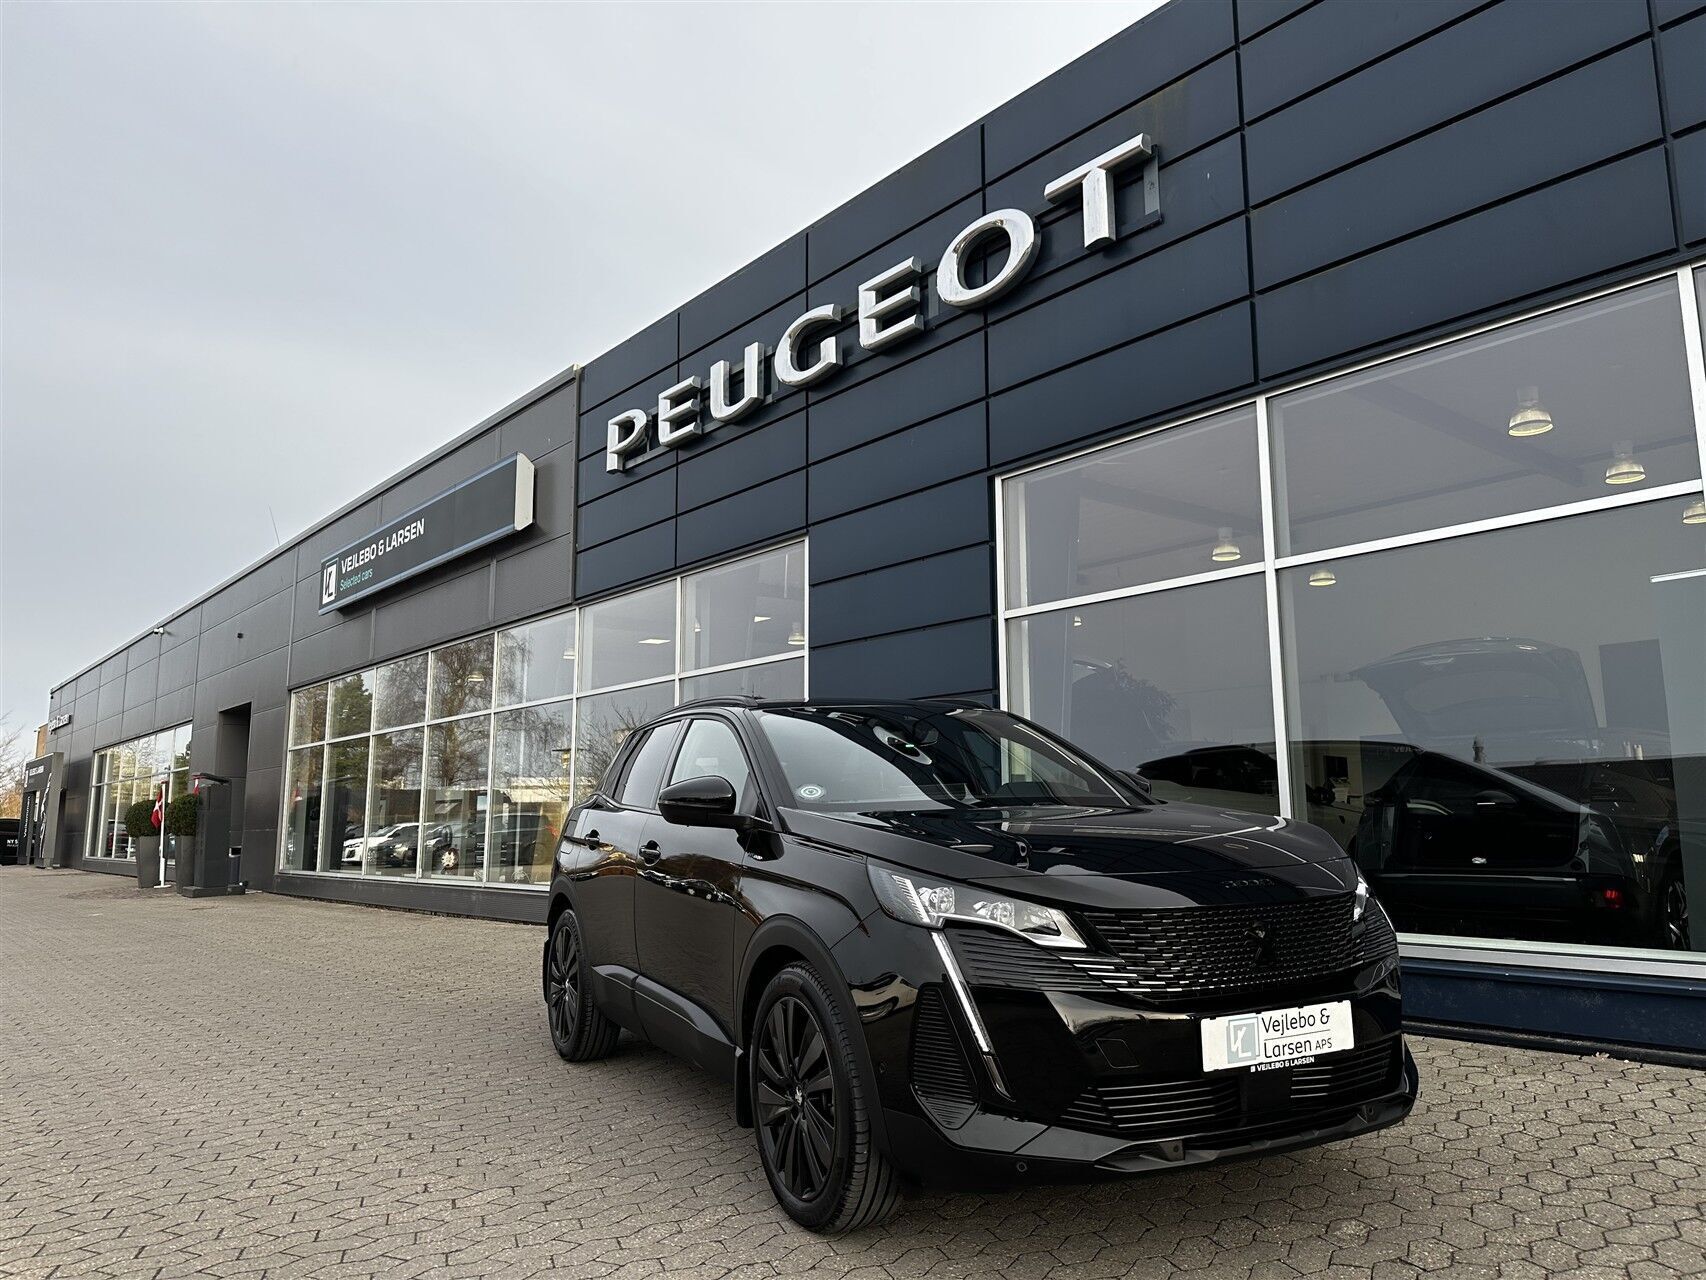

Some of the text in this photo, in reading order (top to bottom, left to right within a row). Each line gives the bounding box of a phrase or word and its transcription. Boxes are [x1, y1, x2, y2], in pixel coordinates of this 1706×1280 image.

[606, 133, 1153, 473] PEUGEOT
[341, 518, 425, 574] VEJLEBO & LARSEN
[339, 568, 373, 591] Selected cars
[1261, 1008, 1331, 1036] Vejlebo &
[1263, 1037, 1333, 1059] Larsen APS
[1256, 1061, 1285, 1072] VEJLEBO
[1290, 1056, 1315, 1067] LARSEN
